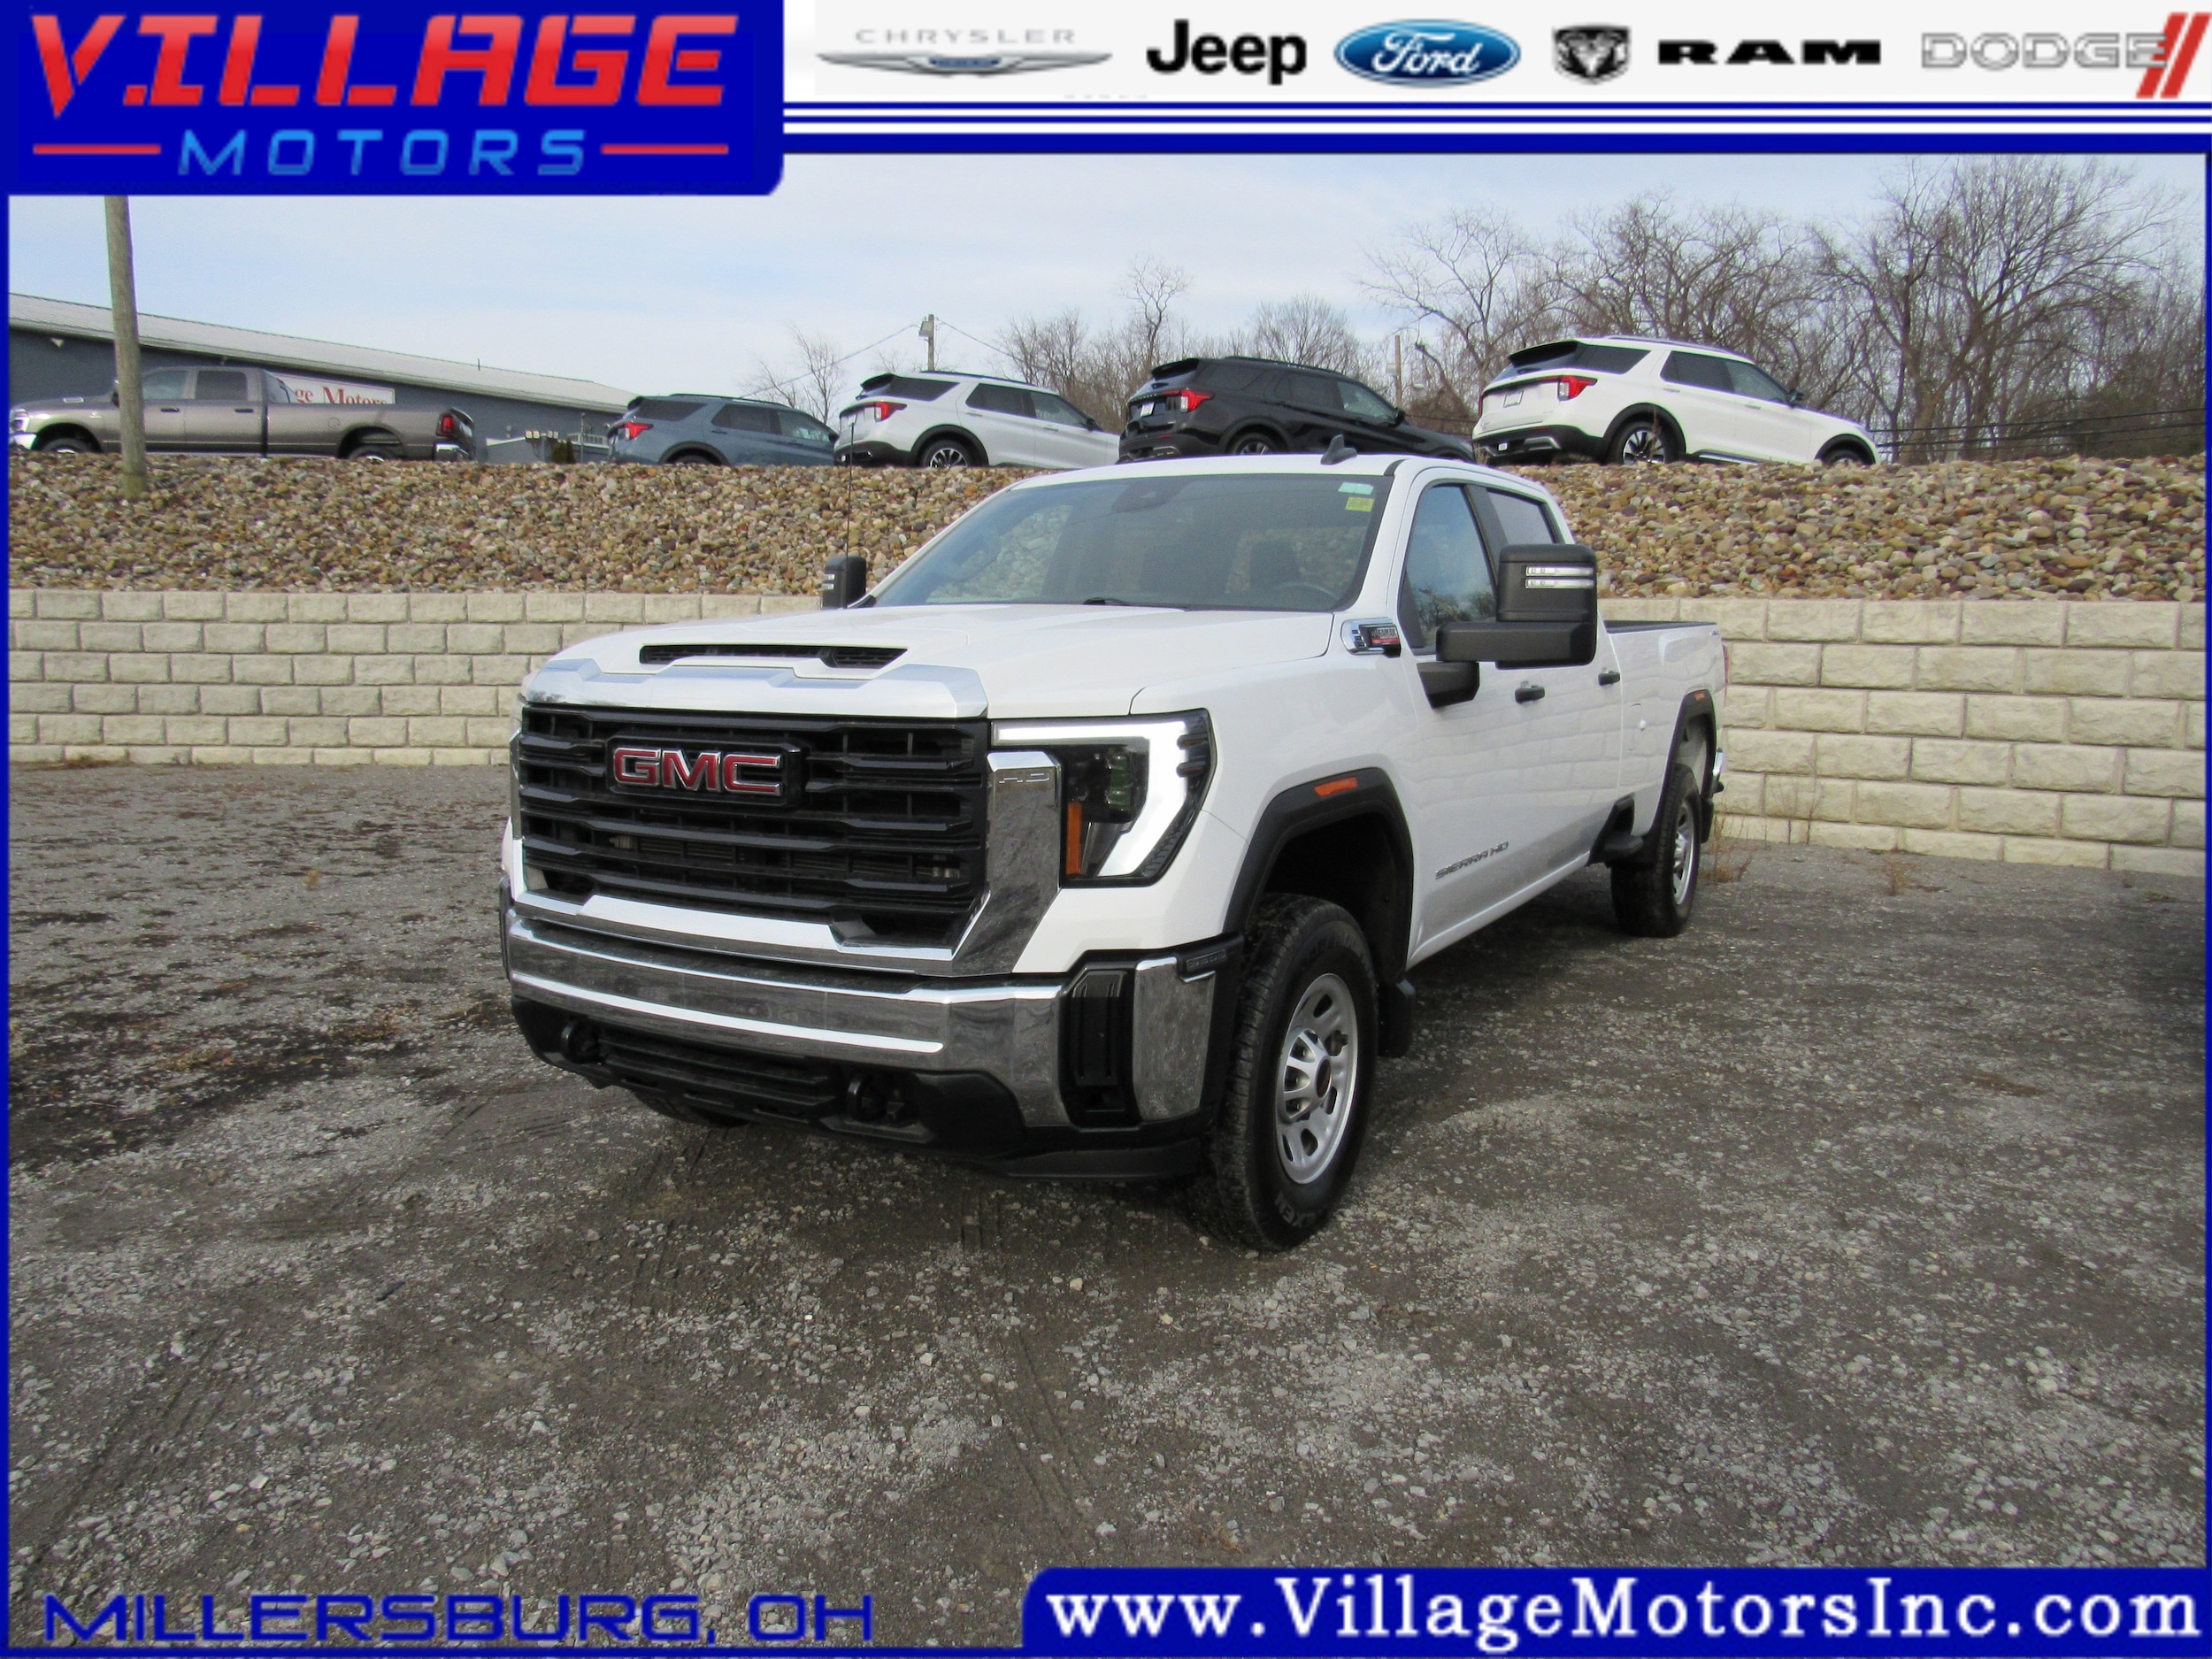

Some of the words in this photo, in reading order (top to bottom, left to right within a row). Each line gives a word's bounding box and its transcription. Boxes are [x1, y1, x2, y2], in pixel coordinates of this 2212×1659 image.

[613, 746, 781, 796] GMC
[1434, 849, 1489, 880] SIERRA
[1489, 841, 1509, 857] HD
